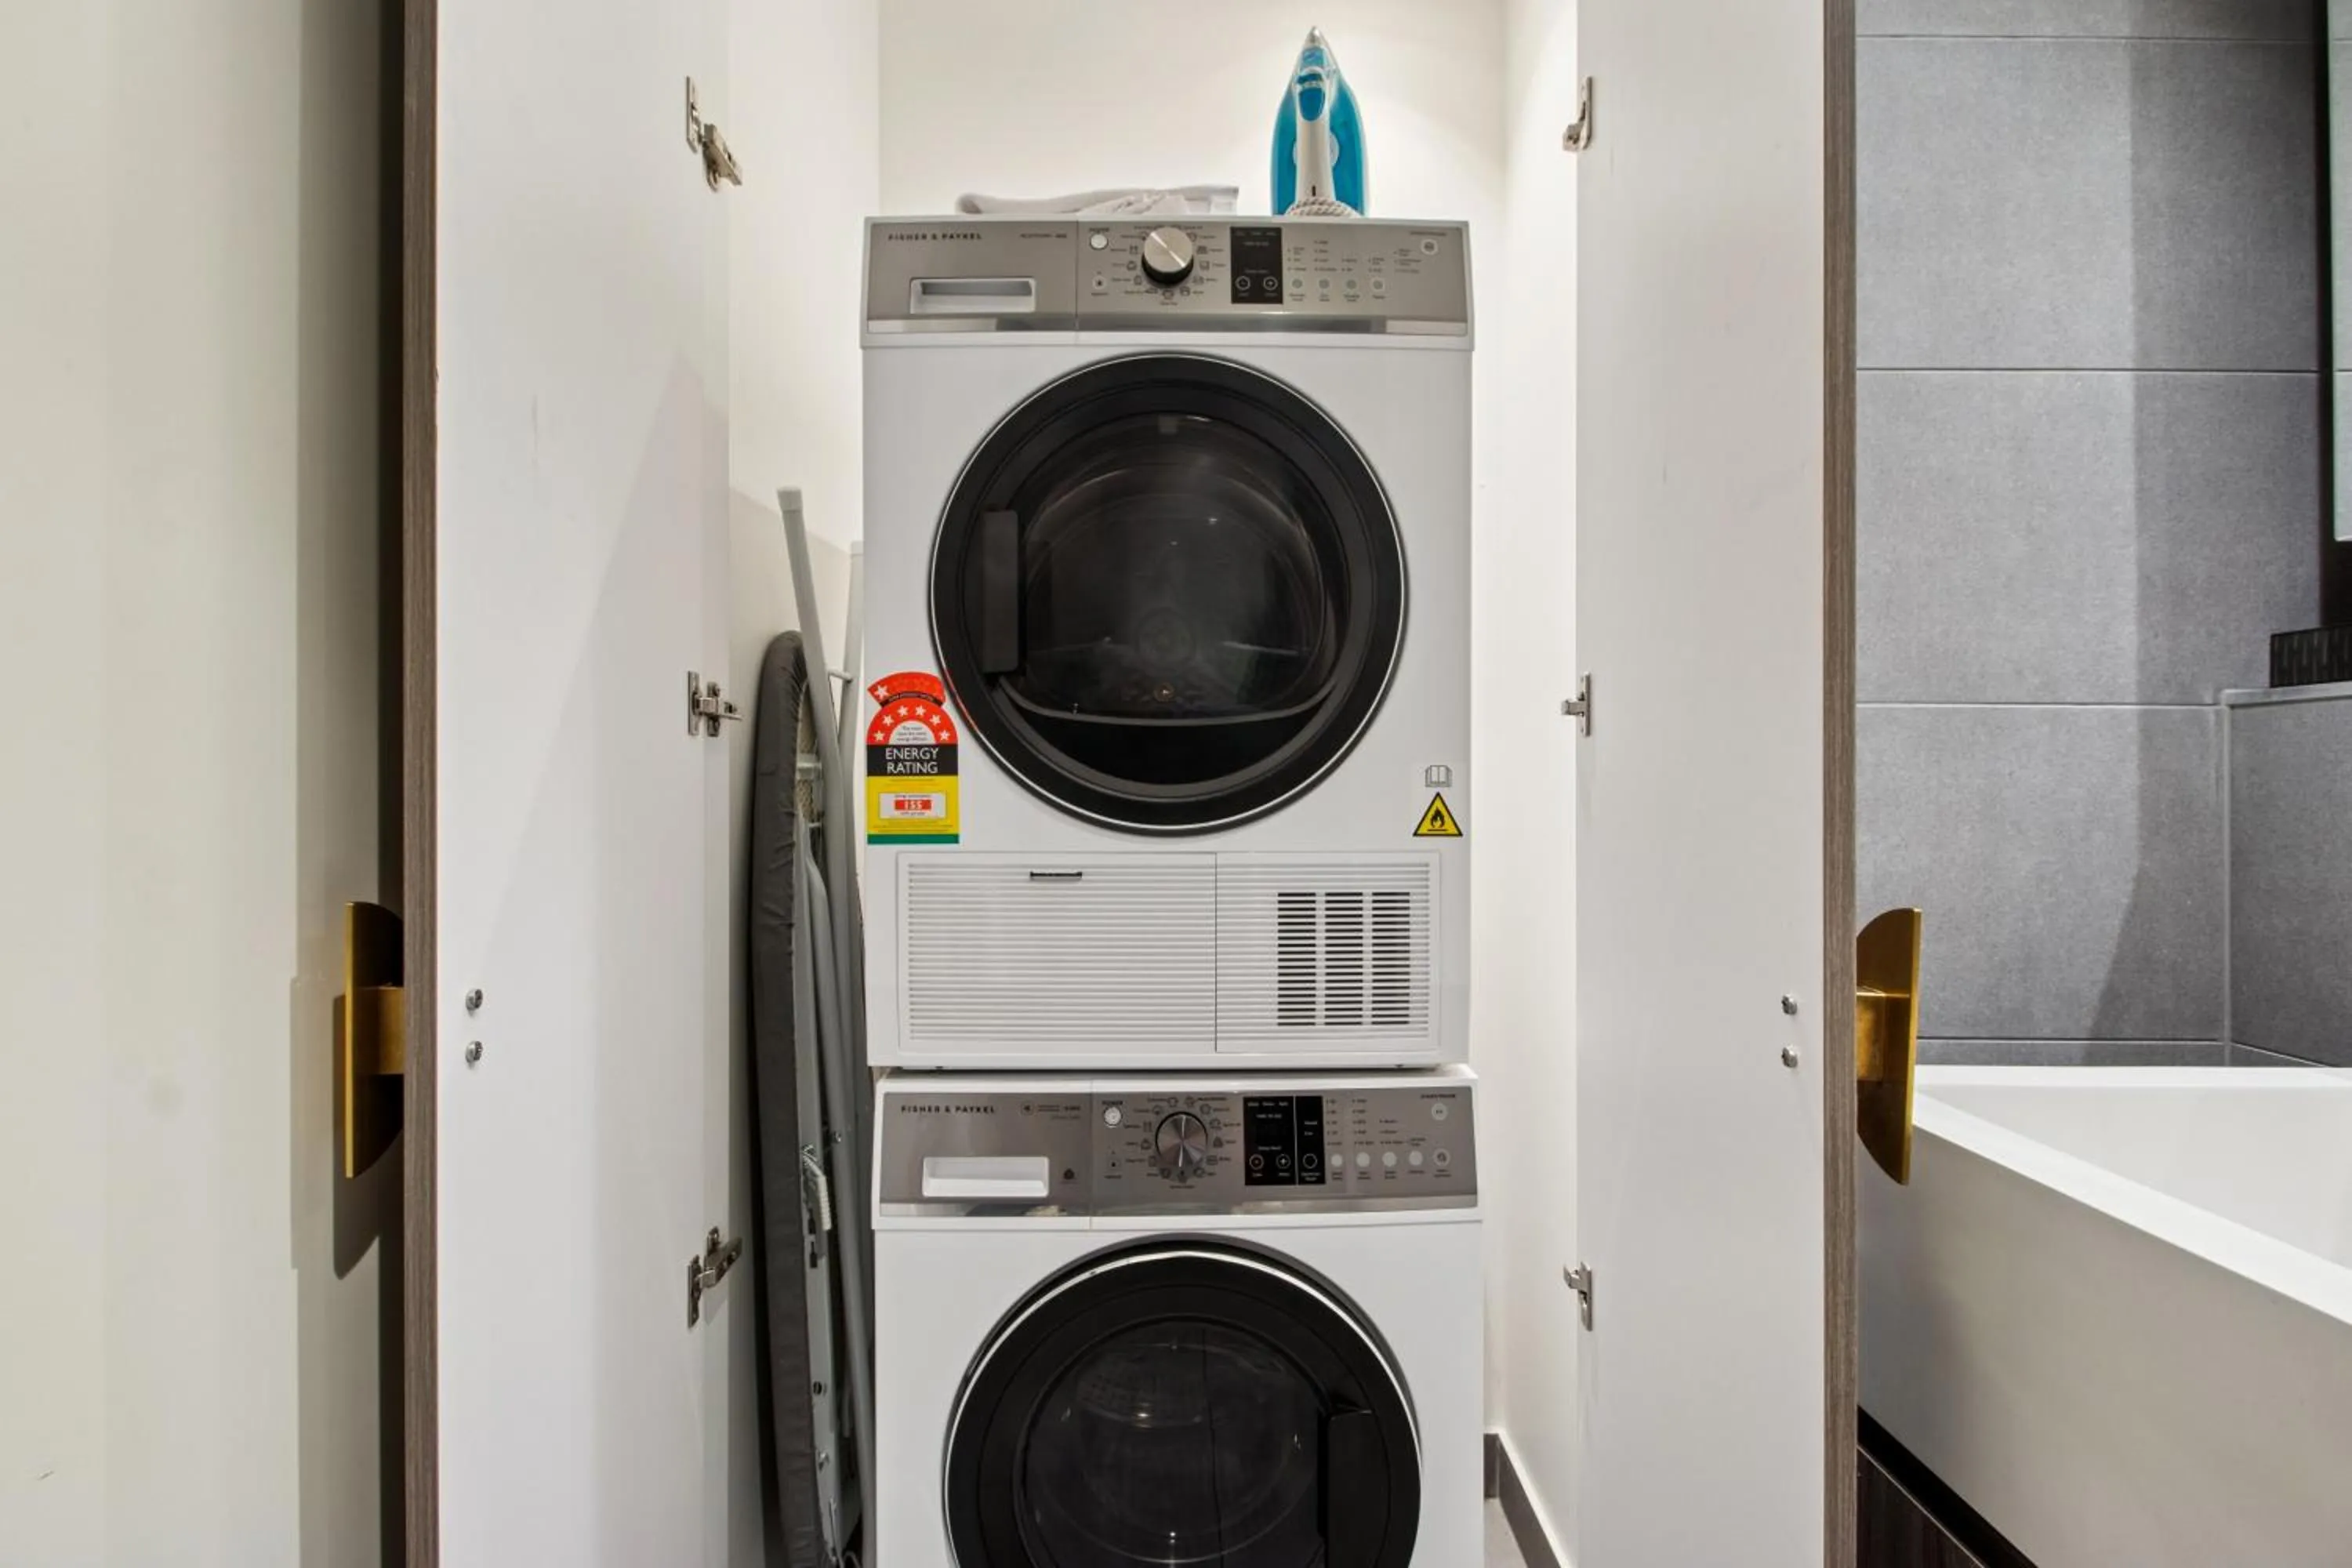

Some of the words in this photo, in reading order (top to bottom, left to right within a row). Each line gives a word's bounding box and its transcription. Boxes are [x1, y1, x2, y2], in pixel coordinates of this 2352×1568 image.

[887, 232, 927, 241] FISHER
[942, 231, 982, 240] PAYKEL
[885, 747, 939, 760] ENERGY
[887, 761, 938, 774] RATING
[901, 1105, 940, 1113] FISHER
